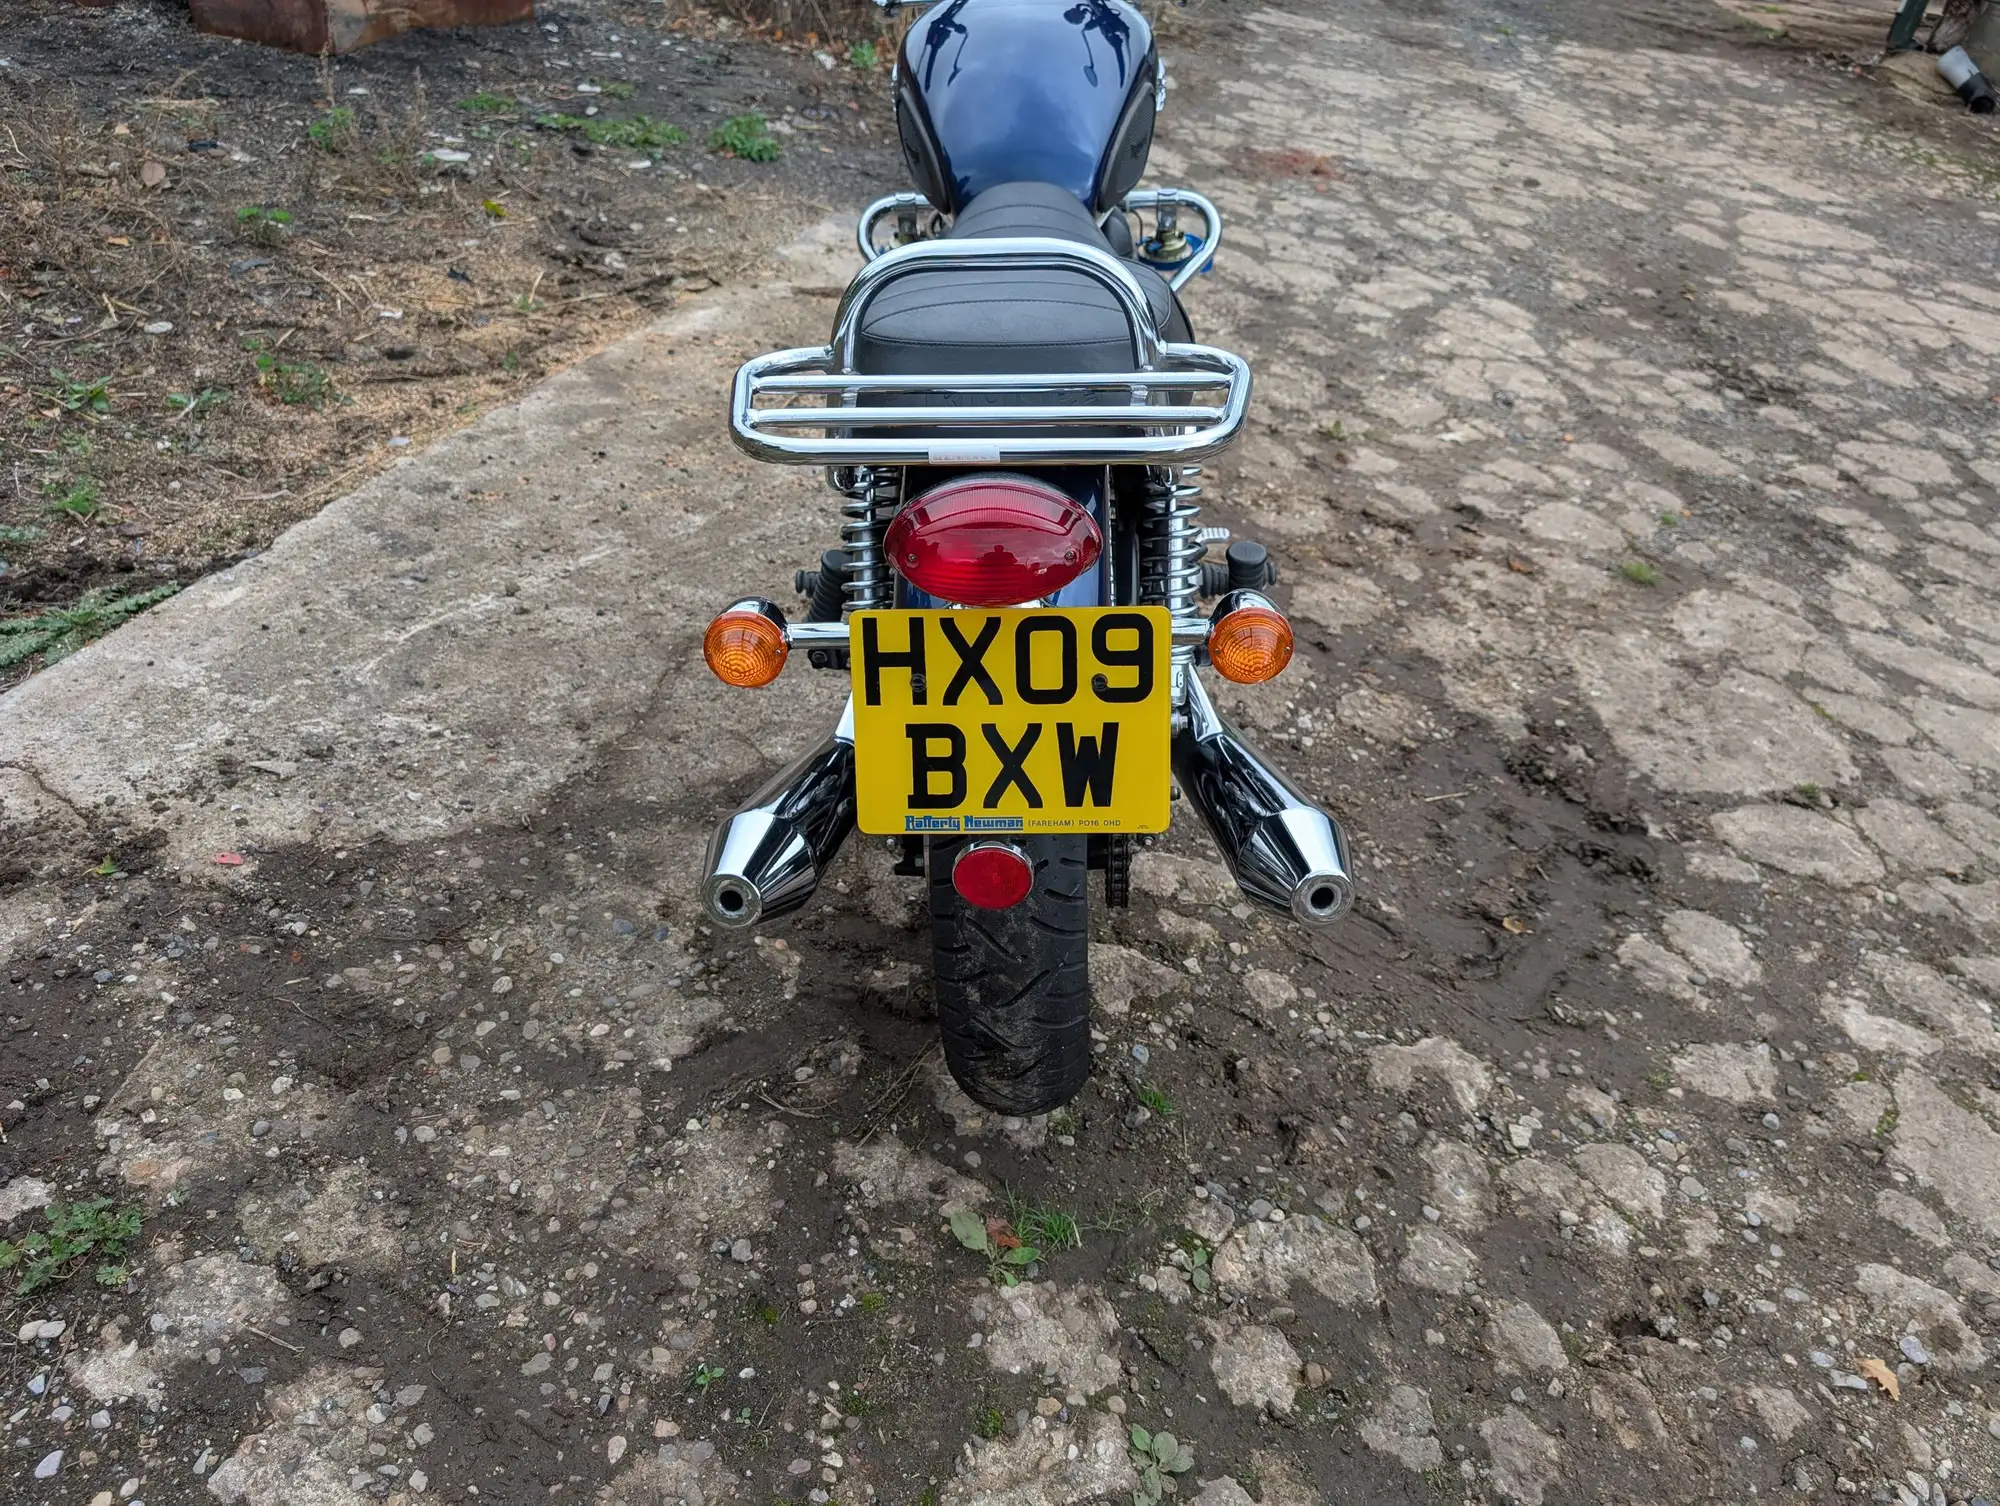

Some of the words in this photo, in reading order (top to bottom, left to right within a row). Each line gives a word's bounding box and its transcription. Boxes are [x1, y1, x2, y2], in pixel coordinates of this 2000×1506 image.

[861, 613, 1154, 706] HX09
[905, 722, 1120, 810] BXW
[904, 815, 961, 832] Rafferty
[963, 816, 1023, 831] Newman
[1027, 819, 1075, 828] (FAREHAM)
